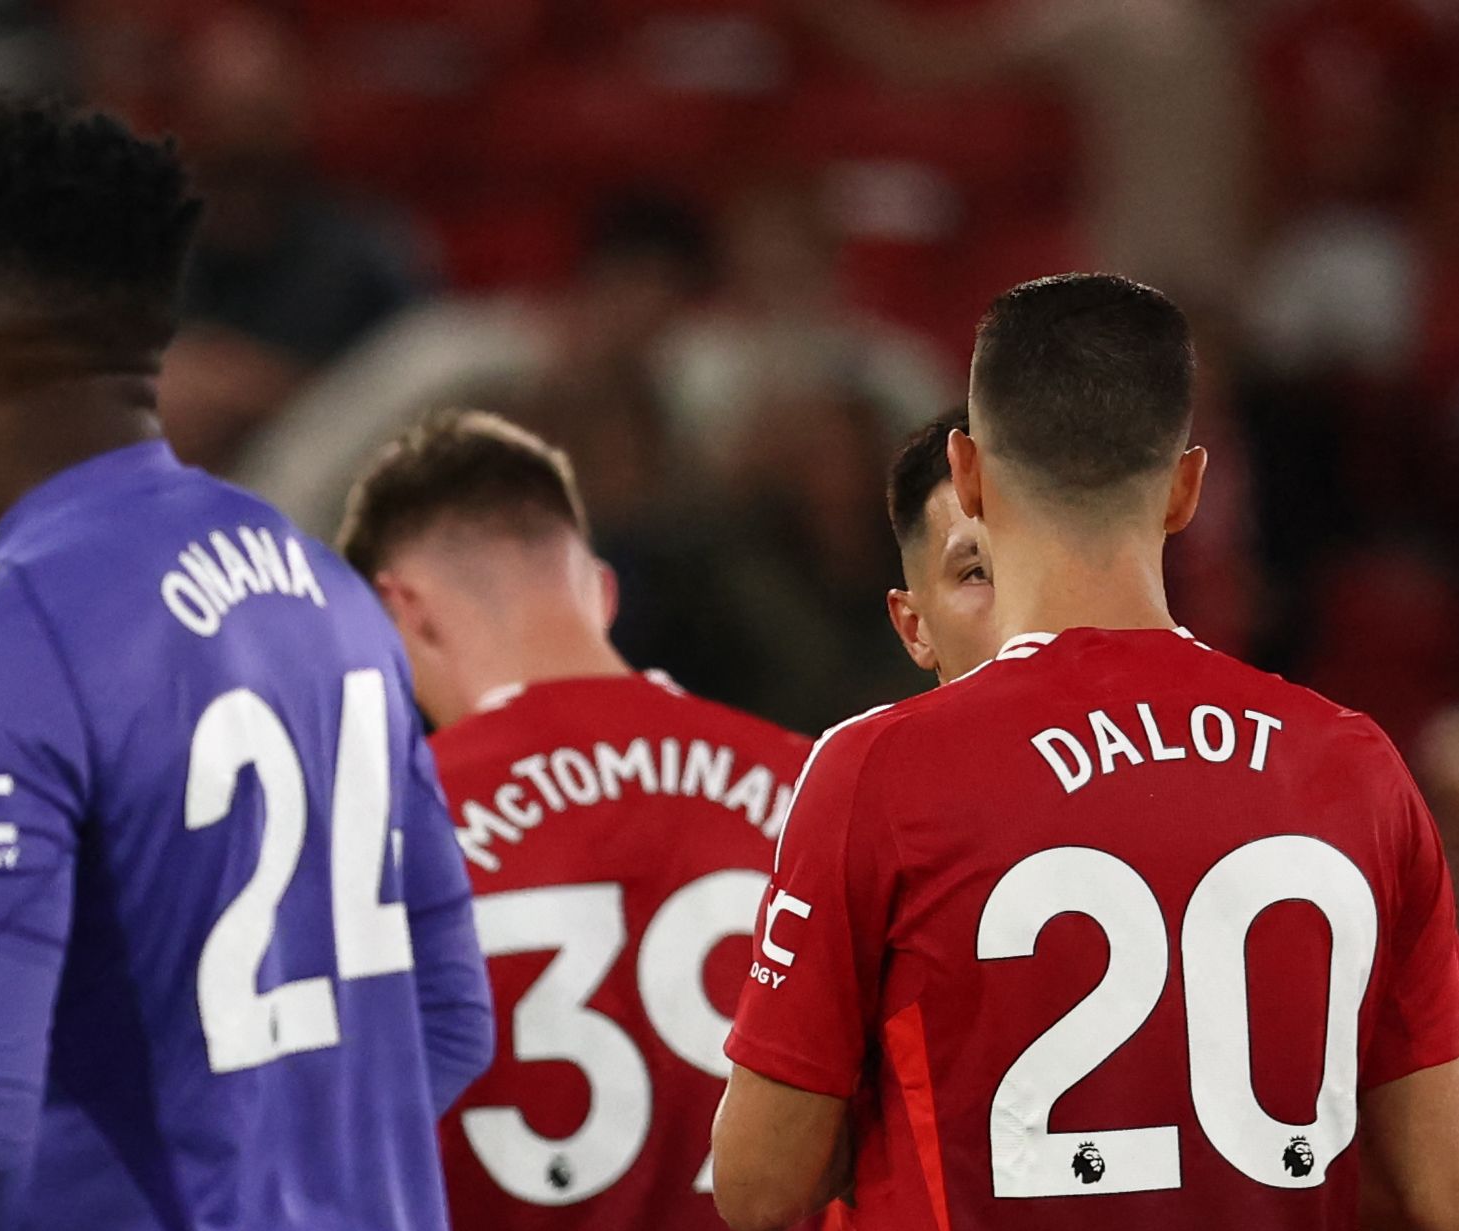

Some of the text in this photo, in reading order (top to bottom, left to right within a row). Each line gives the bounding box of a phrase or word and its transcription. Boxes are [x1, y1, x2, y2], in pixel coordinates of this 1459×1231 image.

[161, 526, 328, 637] ONANA
[1030, 703, 1282, 794] DALOT
[184, 668, 415, 1074] 24
[977, 834, 1378, 1198] 20
